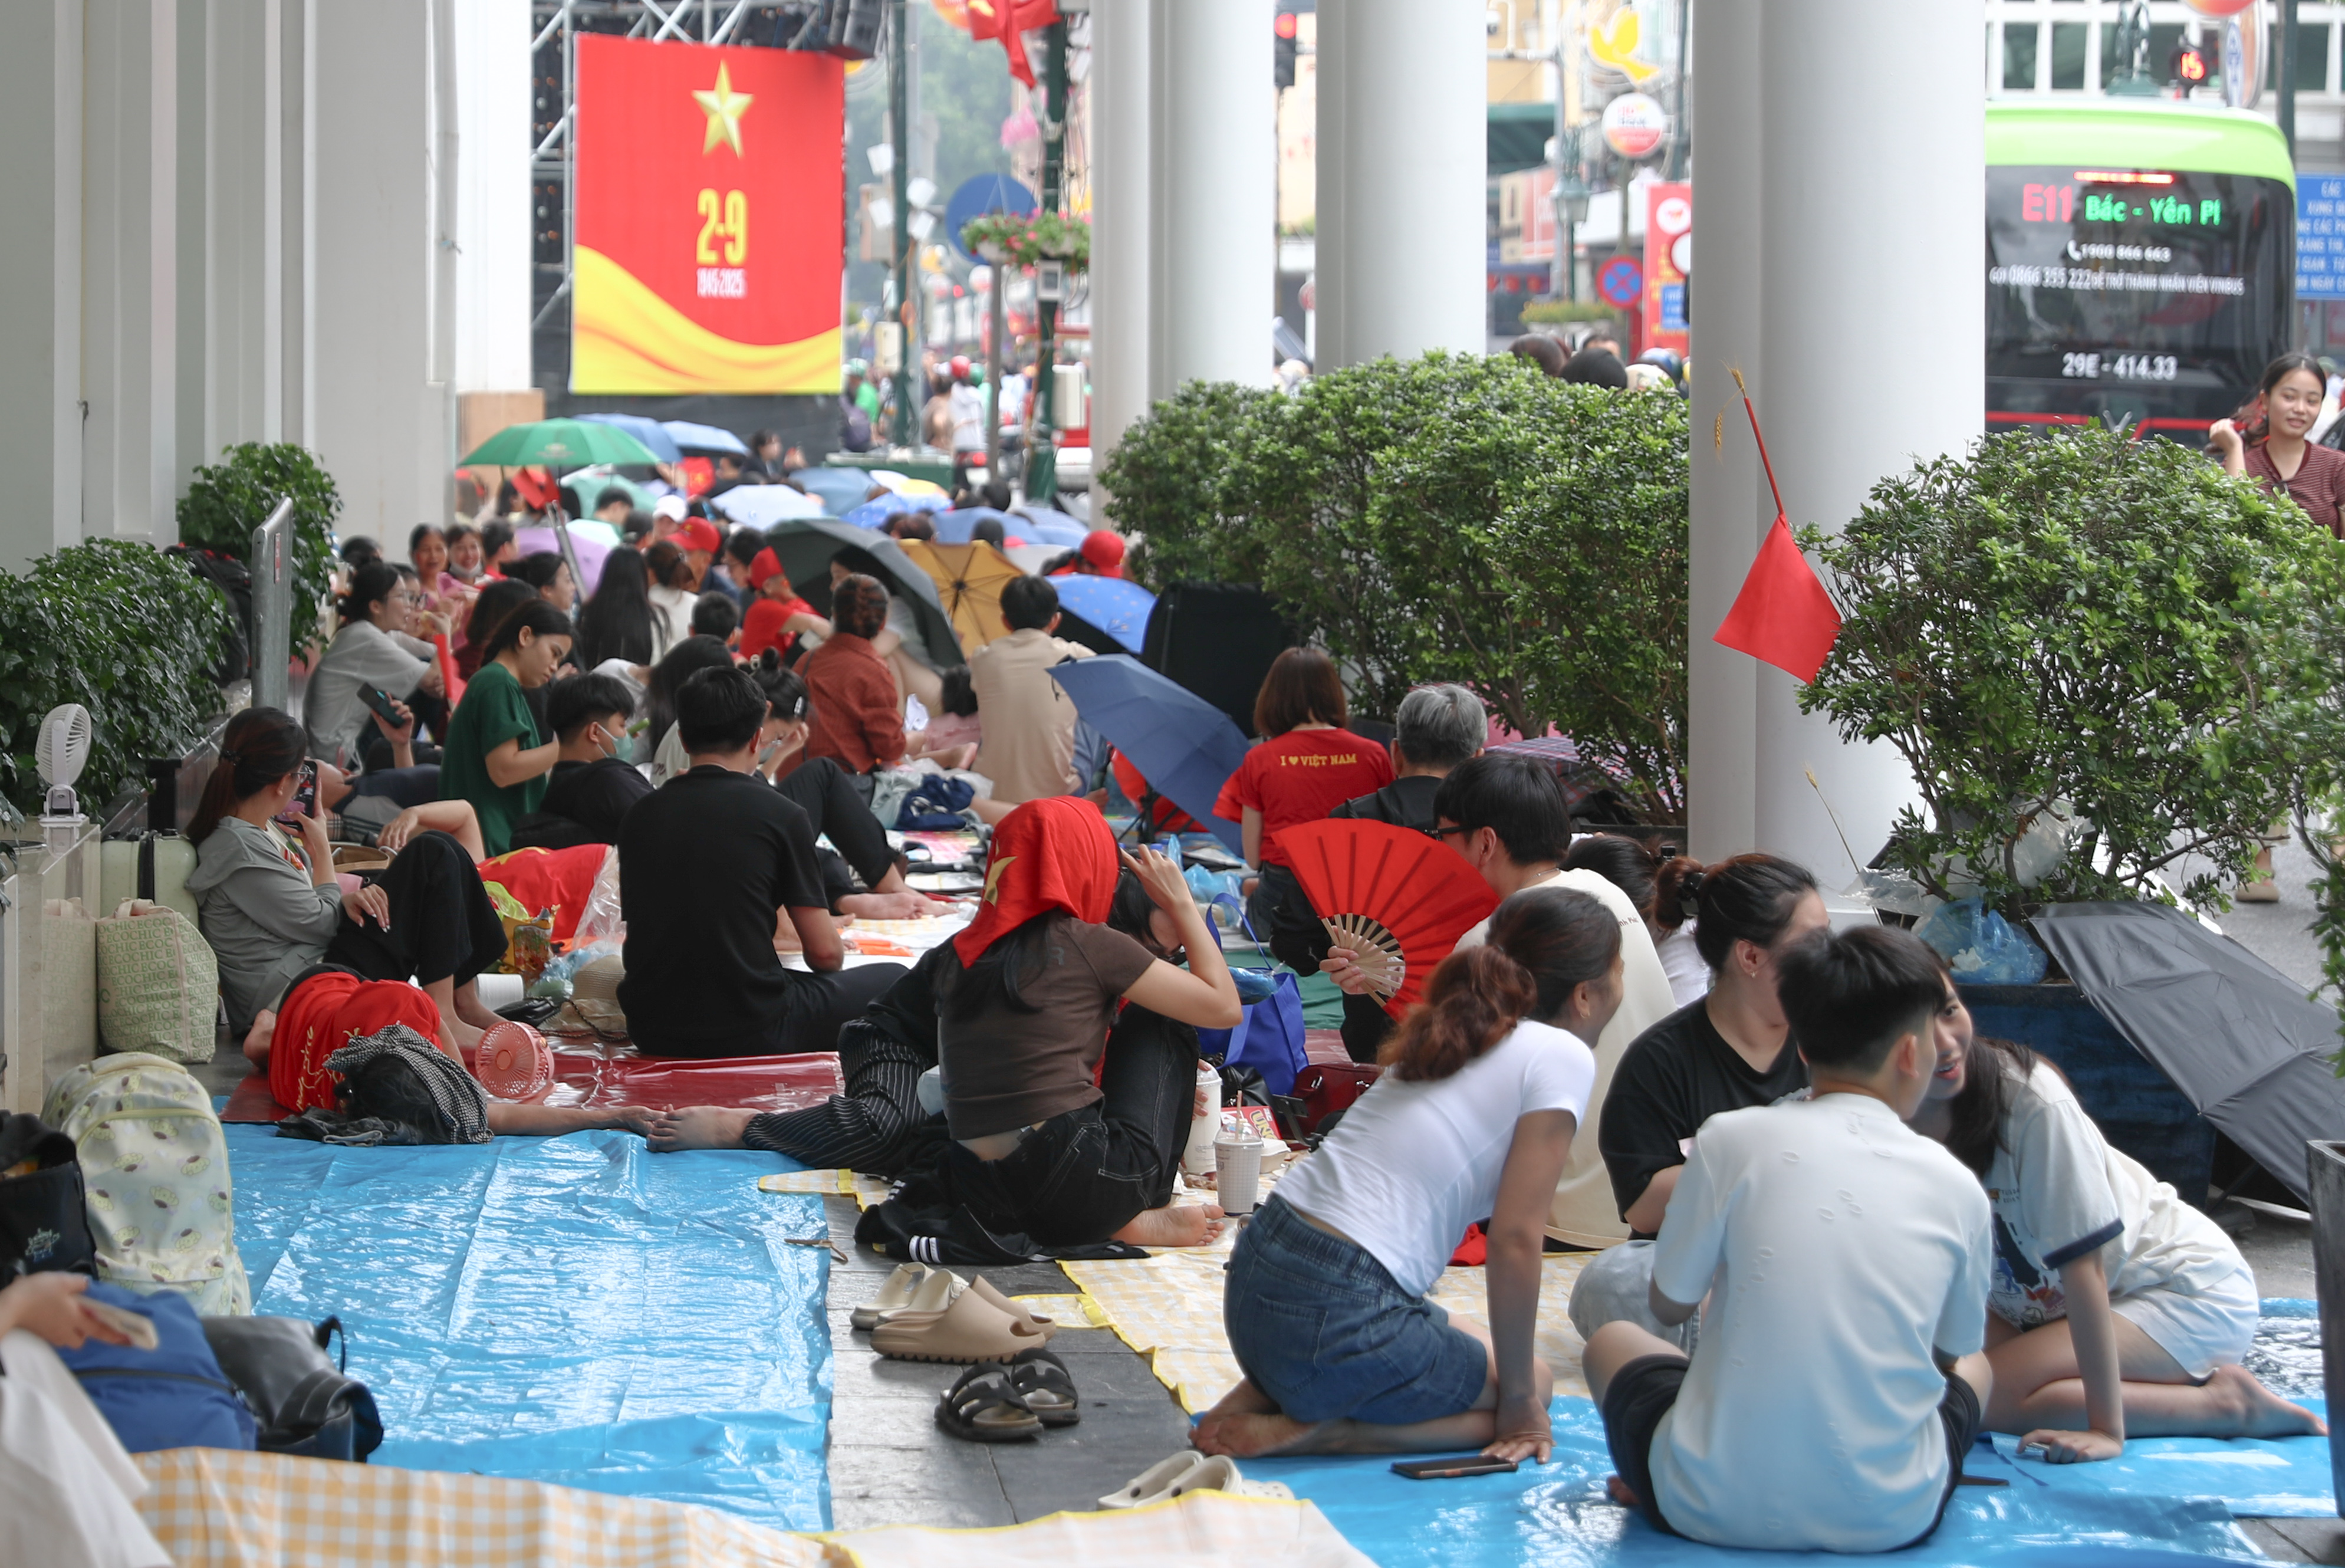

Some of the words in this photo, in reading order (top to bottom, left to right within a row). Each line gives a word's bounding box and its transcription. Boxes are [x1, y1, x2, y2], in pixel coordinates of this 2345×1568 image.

[2022, 183, 2072, 223] E11
[2085, 193, 2128, 222] Bác
[2149, 195, 2192, 223] Yên
[2080, 243, 2115, 259] 1900
[2008, 264, 2042, 287] 0866
[2042, 265, 2067, 288] 355
[2067, 268, 2092, 290] 222
[2209, 275, 2245, 296] VINBUS
[2062, 351, 2101, 379] 29E
[2113, 354, 2178, 381] 414.33
[1280, 755, 1287, 766] I
[1300, 754, 1327, 768] VIỆT
[1330, 753, 1357, 765] NAM
[107, 928, 161, 943] ECOCHIC
[139, 938, 173, 950] ECOC
[108, 949, 163, 965] ECOCHIC
[141, 959, 175, 972] ECOC
[112, 971, 166, 986] ECOCHIC
[143, 979, 178, 993] ECOC
